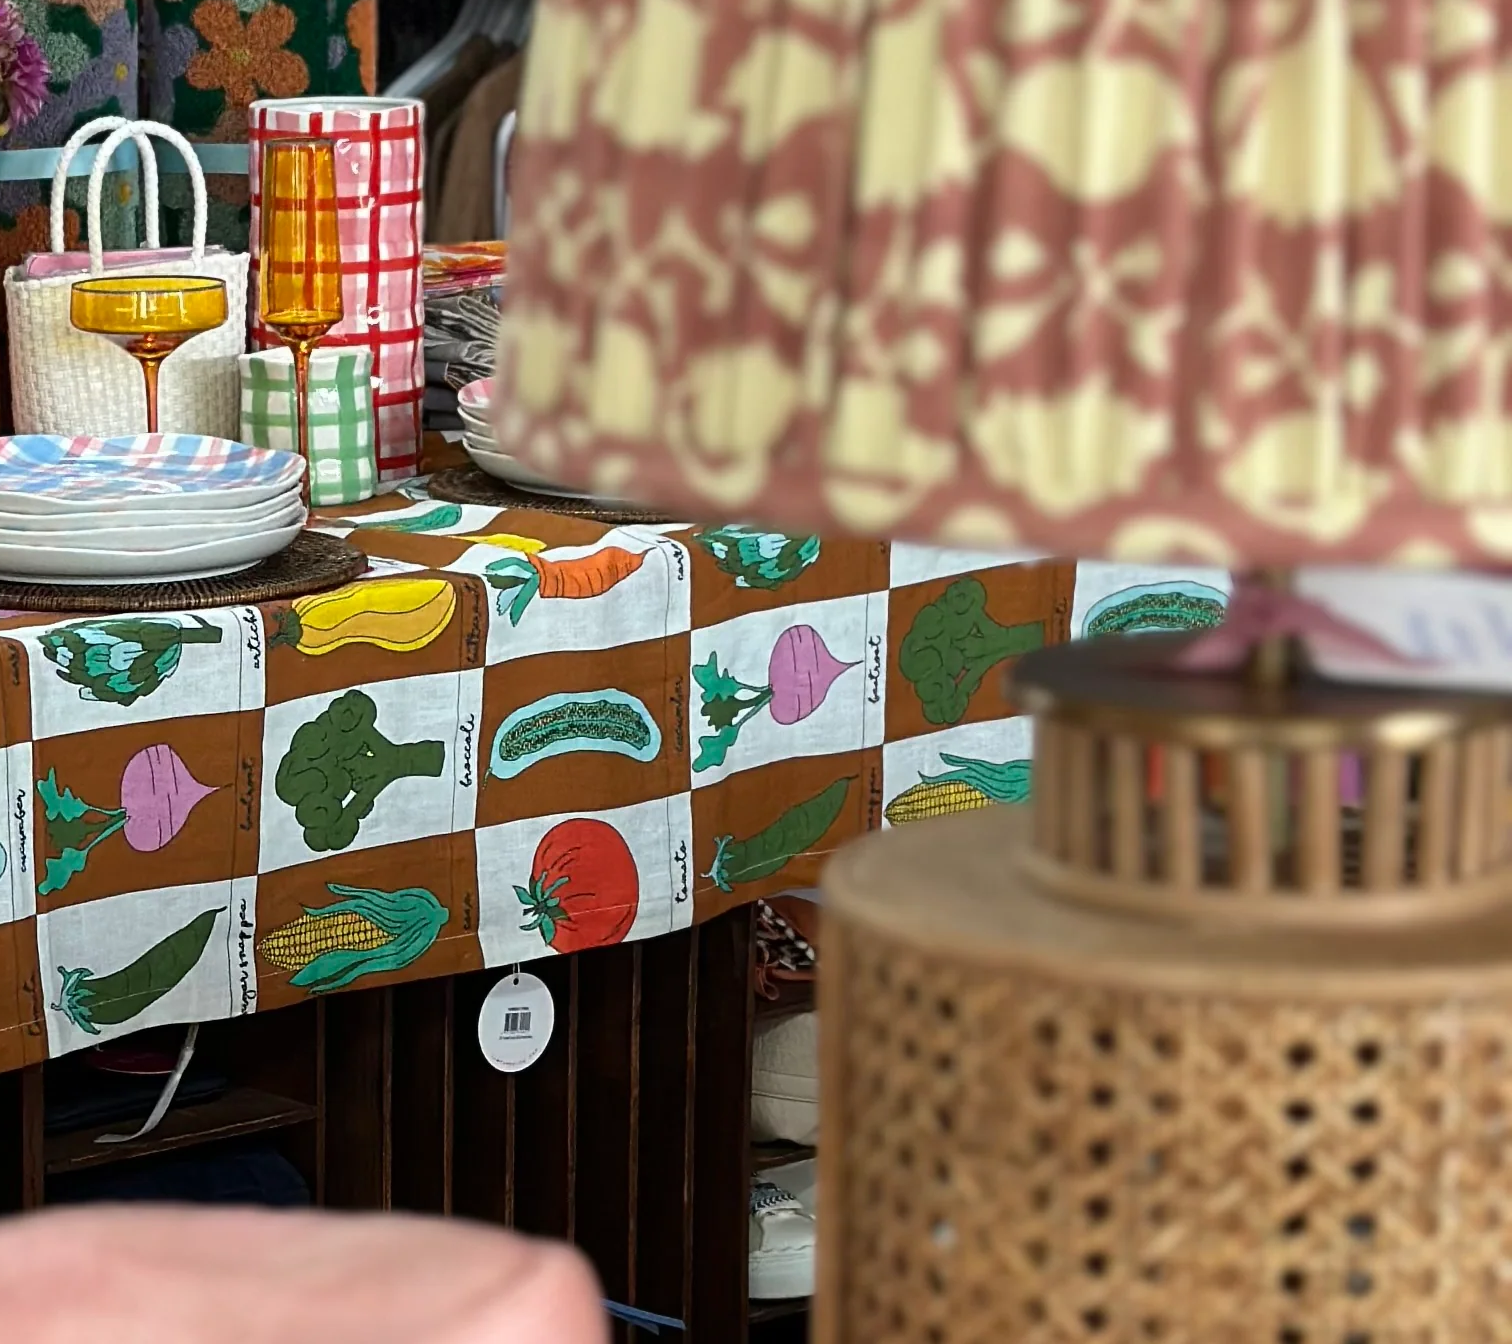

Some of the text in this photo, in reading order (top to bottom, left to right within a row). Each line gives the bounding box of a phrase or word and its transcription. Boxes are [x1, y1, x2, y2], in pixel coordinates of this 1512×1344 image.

[243, 607, 260, 669] articho
[460, 713, 475, 788] broccoli
[14, 789, 26, 873] cucumber
[674, 840, 688, 904] tomato
[239, 898, 253, 927] pea
